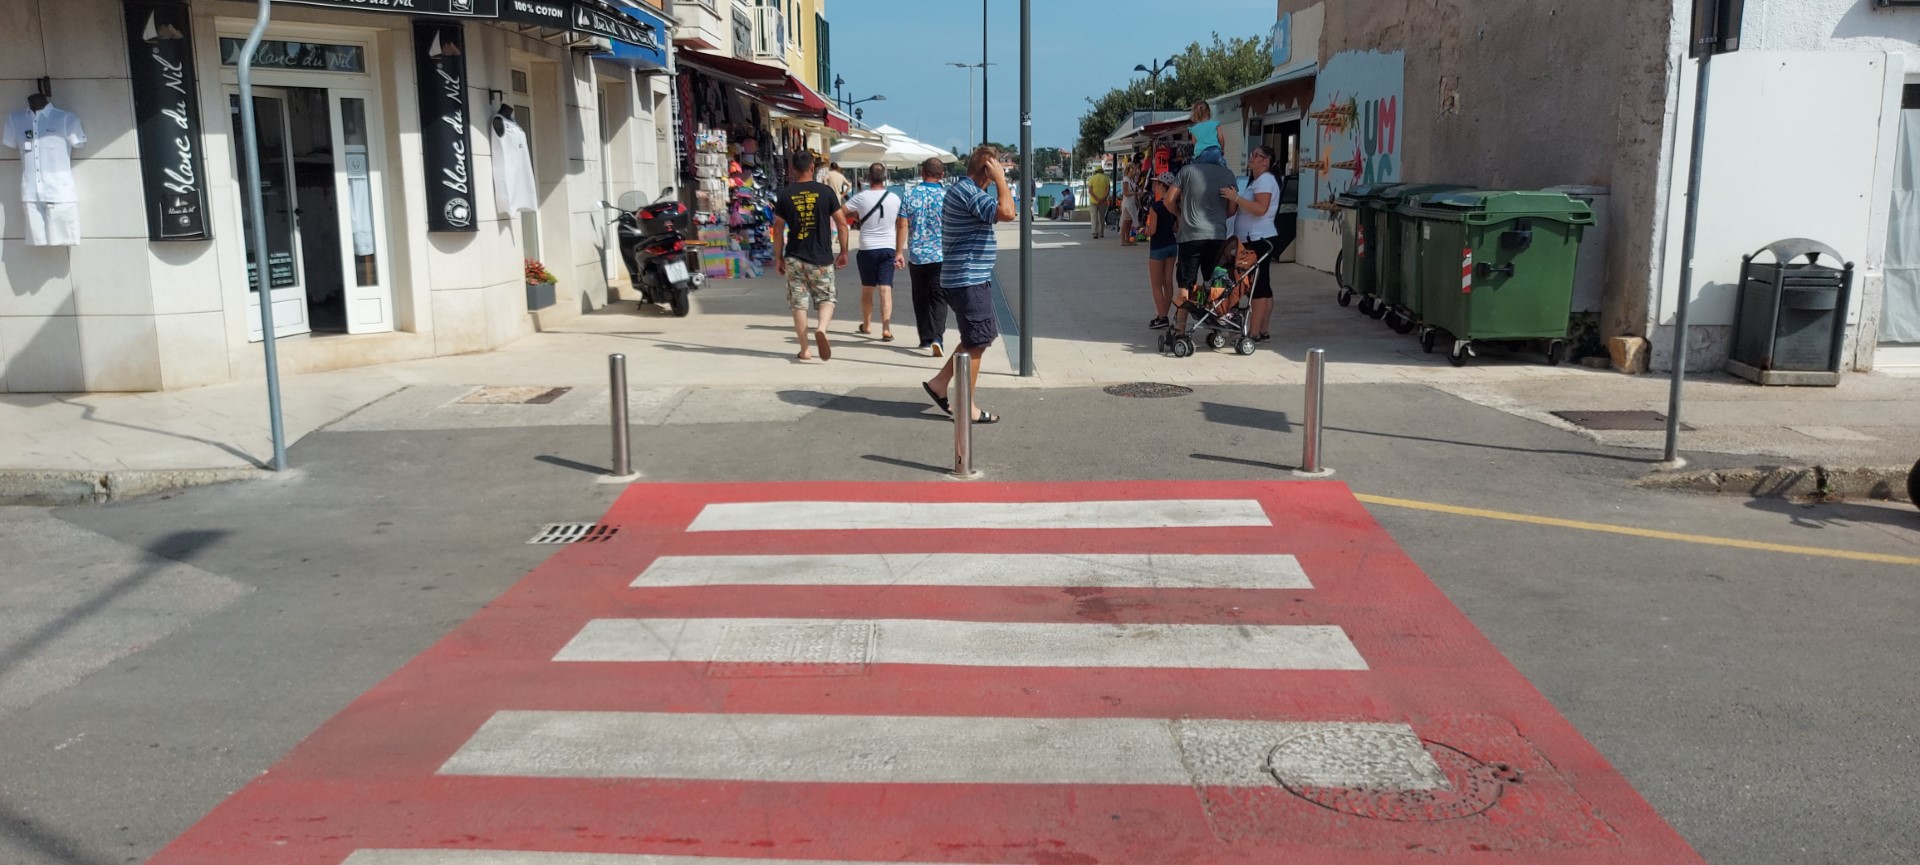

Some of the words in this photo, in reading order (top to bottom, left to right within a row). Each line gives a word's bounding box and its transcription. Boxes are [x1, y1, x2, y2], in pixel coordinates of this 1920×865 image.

[535, 5, 563, 18] COTON
[152, 53, 187, 95] Nil
[302, 49, 324, 67] du
[436, 68, 462, 104] Nil
[161, 100, 188, 130] du
[441, 109, 464, 135] du
[1363, 94, 1396, 157] UM
[163, 135, 195, 193] blanc
[442, 139, 468, 194] blanc
